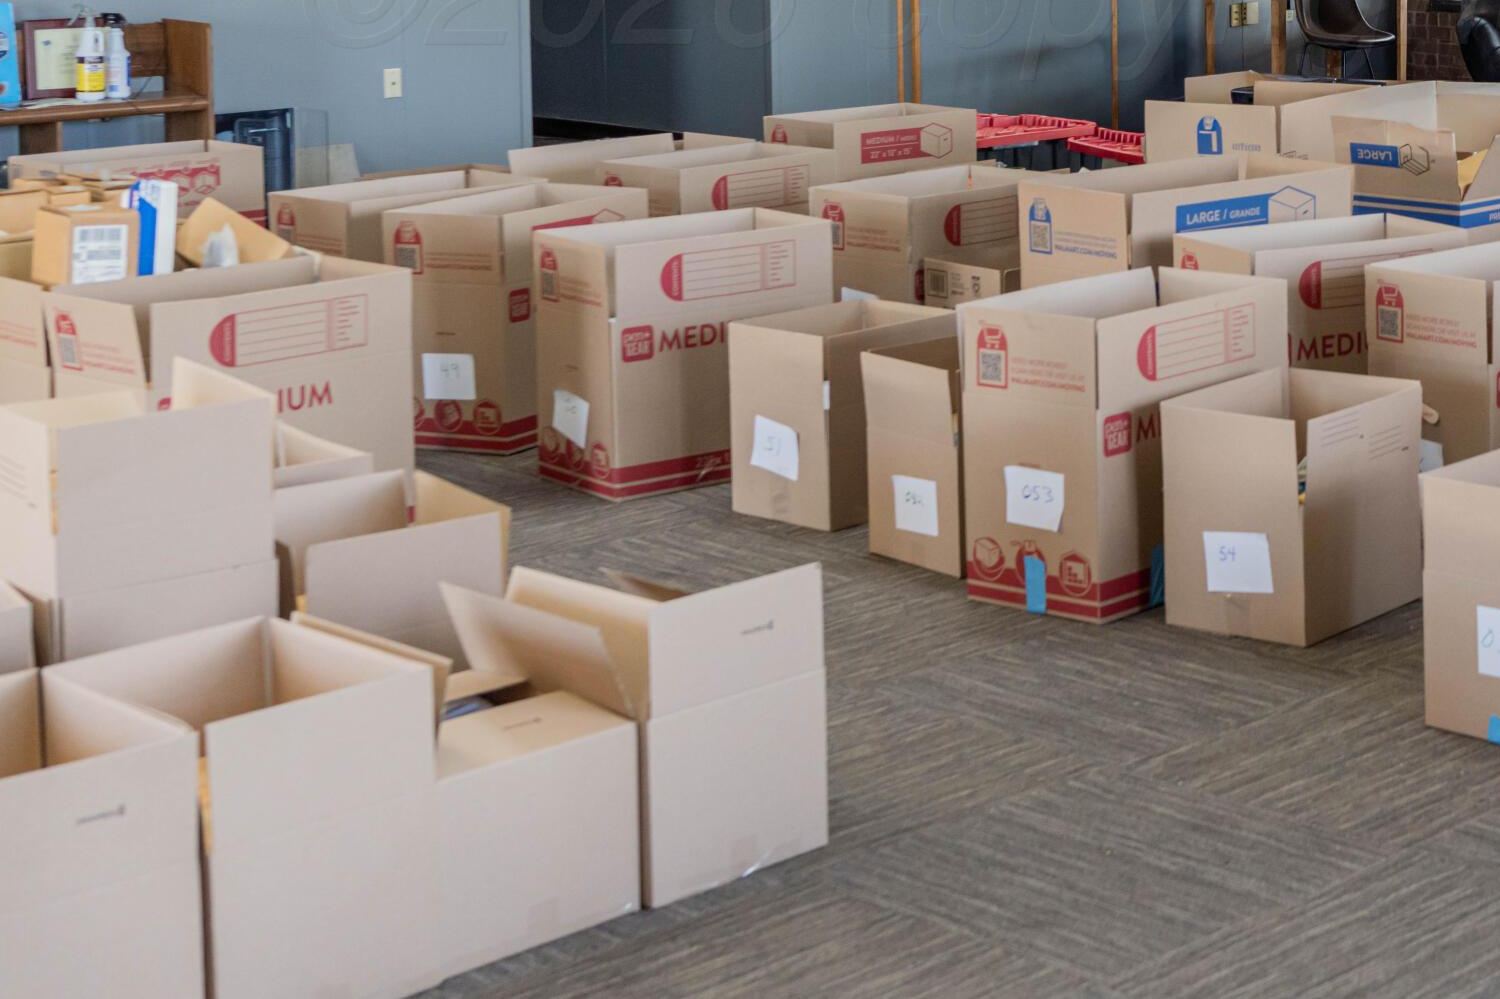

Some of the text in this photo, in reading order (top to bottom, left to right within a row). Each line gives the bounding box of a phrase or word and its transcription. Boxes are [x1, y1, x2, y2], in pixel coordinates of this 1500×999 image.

[1187, 210, 1220, 225] LARGE
[659, 322, 728, 353] MEDI
[1297, 330, 1369, 361] MEDI
[277, 381, 333, 414] IUM
[1022, 484, 1054, 503] 053
[1218, 545, 1236, 562] 54
